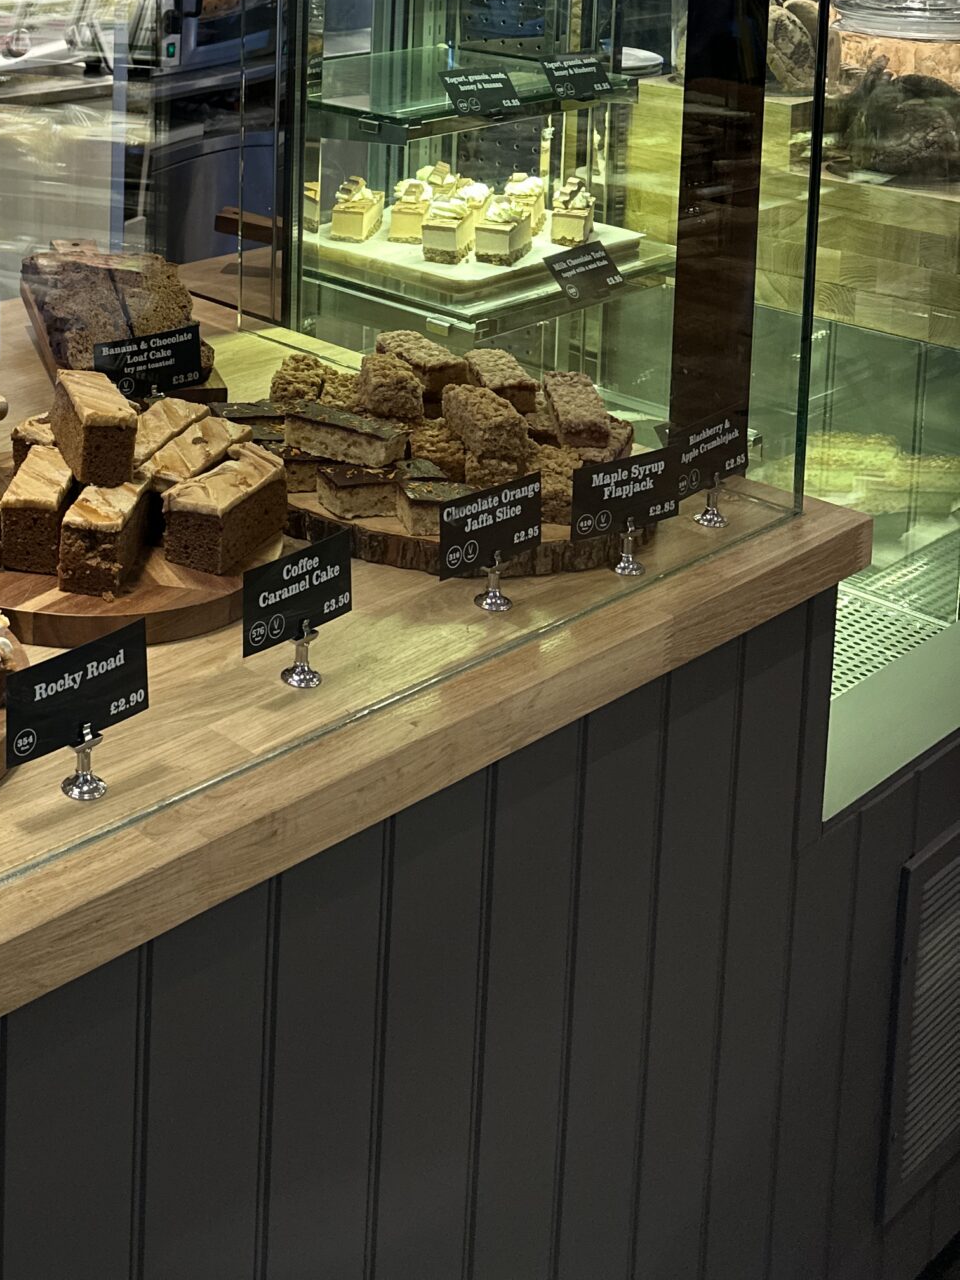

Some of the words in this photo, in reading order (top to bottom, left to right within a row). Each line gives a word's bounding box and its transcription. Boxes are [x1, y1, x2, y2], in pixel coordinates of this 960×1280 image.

[553, 262, 568, 271] Milk
[102, 344, 138, 356] Banana
[140, 341, 148, 349] &
[150, 333, 192, 348] Chocolate
[127, 352, 147, 363] Loaf
[149, 348, 172, 360] Cake
[124, 366, 134, 374] try
[148, 358, 175, 369] toasted!
[173, 372, 199, 384] £3.20
[689, 424, 723, 445] Blackberry
[725, 419, 730, 428] &
[681, 448, 699, 463] Apple
[700, 428, 739, 453] Crumblejack
[726, 454, 745, 470] £2.85
[592, 469, 628, 487] Maple
[631, 461, 665, 479] Syrup
[603, 477, 654, 500] Flapjack
[443, 496, 499, 522] Chocolate
[501, 482, 540, 503] Orange
[649, 500, 675, 516] £2.85
[465, 513, 493, 532] Jaffa
[496, 505, 521, 522] Slice
[514, 525, 539, 543] £2.95
[283, 557, 319, 580] Coffee
[259, 575, 309, 608] Caramel
[313, 565, 340, 585] Cake
[324, 592, 350, 614] £3.50
[34, 671, 83, 702] Rocky
[86, 649, 125, 679] Road
[110, 689, 144, 715] £2.90
[17, 735, 33, 747] 354
